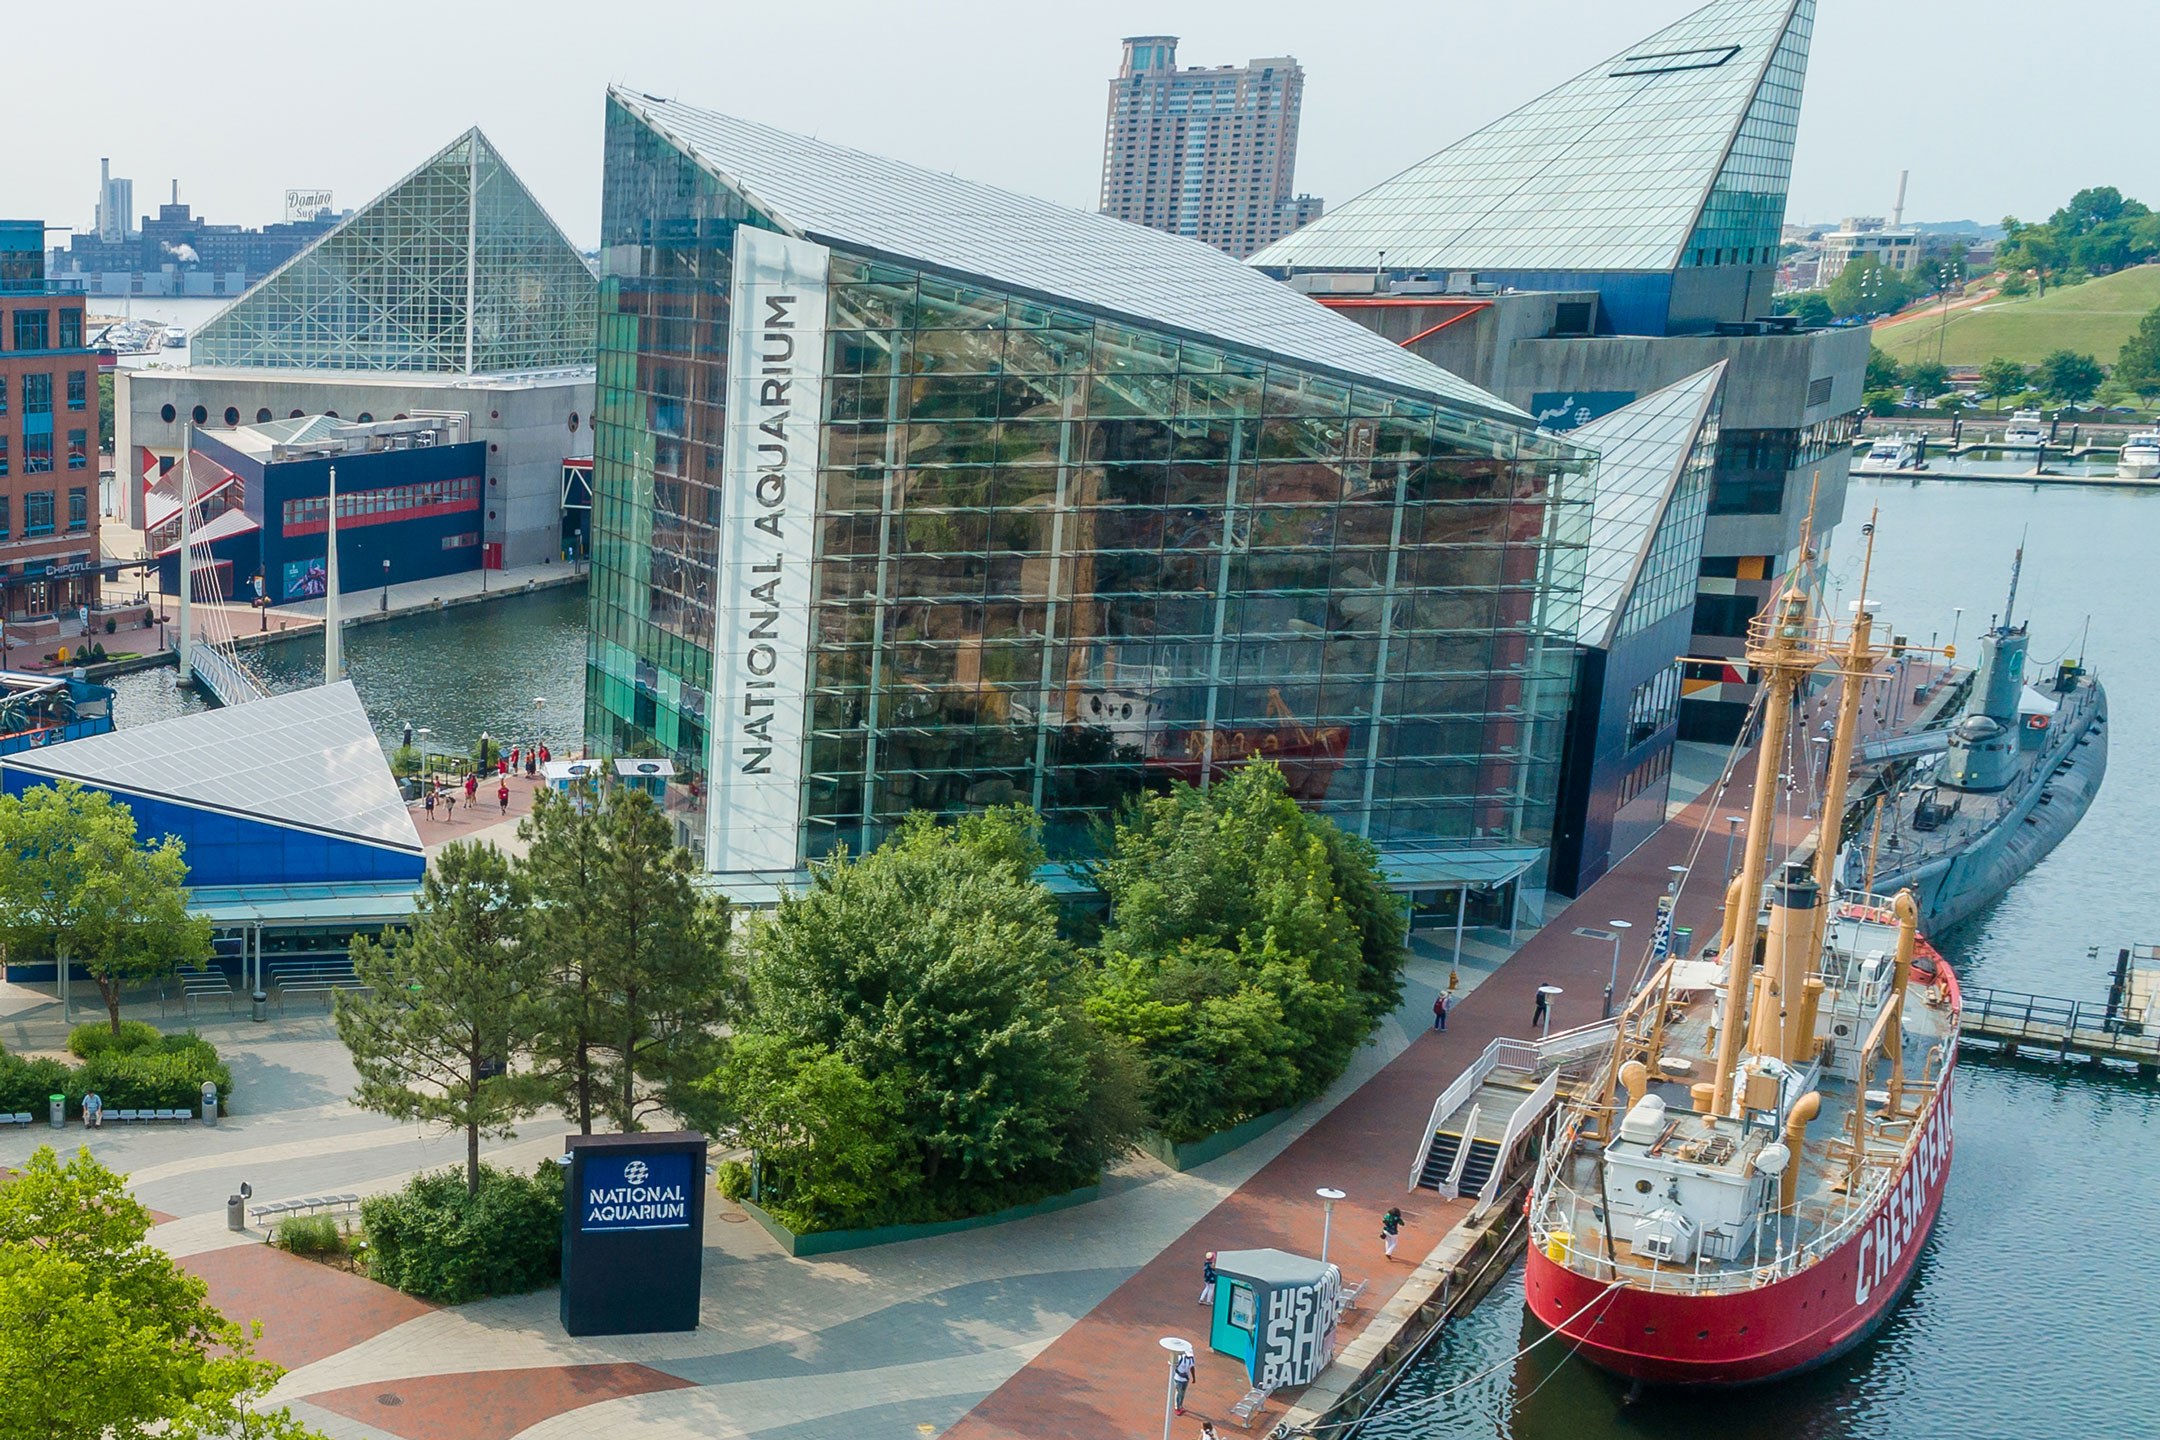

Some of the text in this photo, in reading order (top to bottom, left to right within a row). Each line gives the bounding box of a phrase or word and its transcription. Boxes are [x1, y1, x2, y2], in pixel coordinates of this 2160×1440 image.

[288, 191, 331, 208] Domino
[296, 207, 317, 221] Sug
[742, 296, 797, 774] NATIONAL AQUARIUM
[46, 561, 91, 575] CHIPOTLE
[590, 1185, 685, 1204] NATIONAL
[1856, 1068, 1954, 1305] CHESAPEAK
[588, 1203, 685, 1221] AQUARIUM
